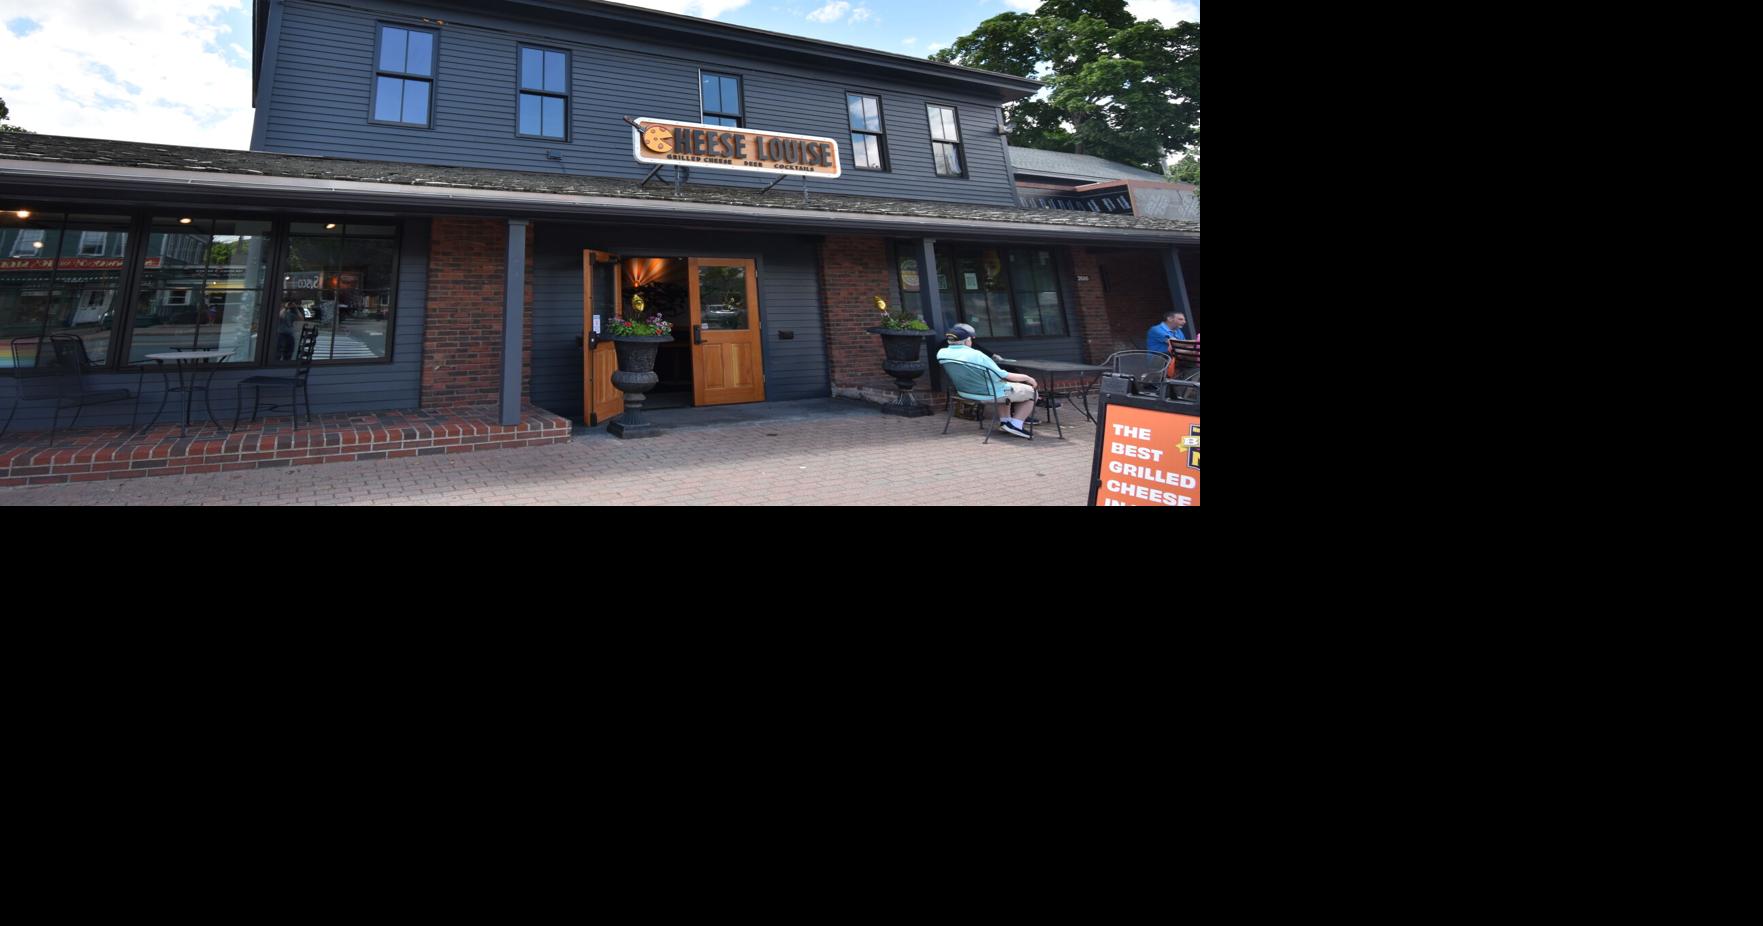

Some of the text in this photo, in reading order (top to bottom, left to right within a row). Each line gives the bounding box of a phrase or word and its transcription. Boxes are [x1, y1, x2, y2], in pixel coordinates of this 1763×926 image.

[666, 153, 701, 162] GRILLED
[703, 157, 733, 165] CHEESE
[773, 163, 815, 172] COCKTAILS
[756, 135, 833, 168] LOUISE
[1112, 423, 1151, 440] THE
[1111, 441, 1163, 462] BEST
[1109, 460, 1196, 489] GRILLED
[1106, 479, 1192, 506] CHEESE
